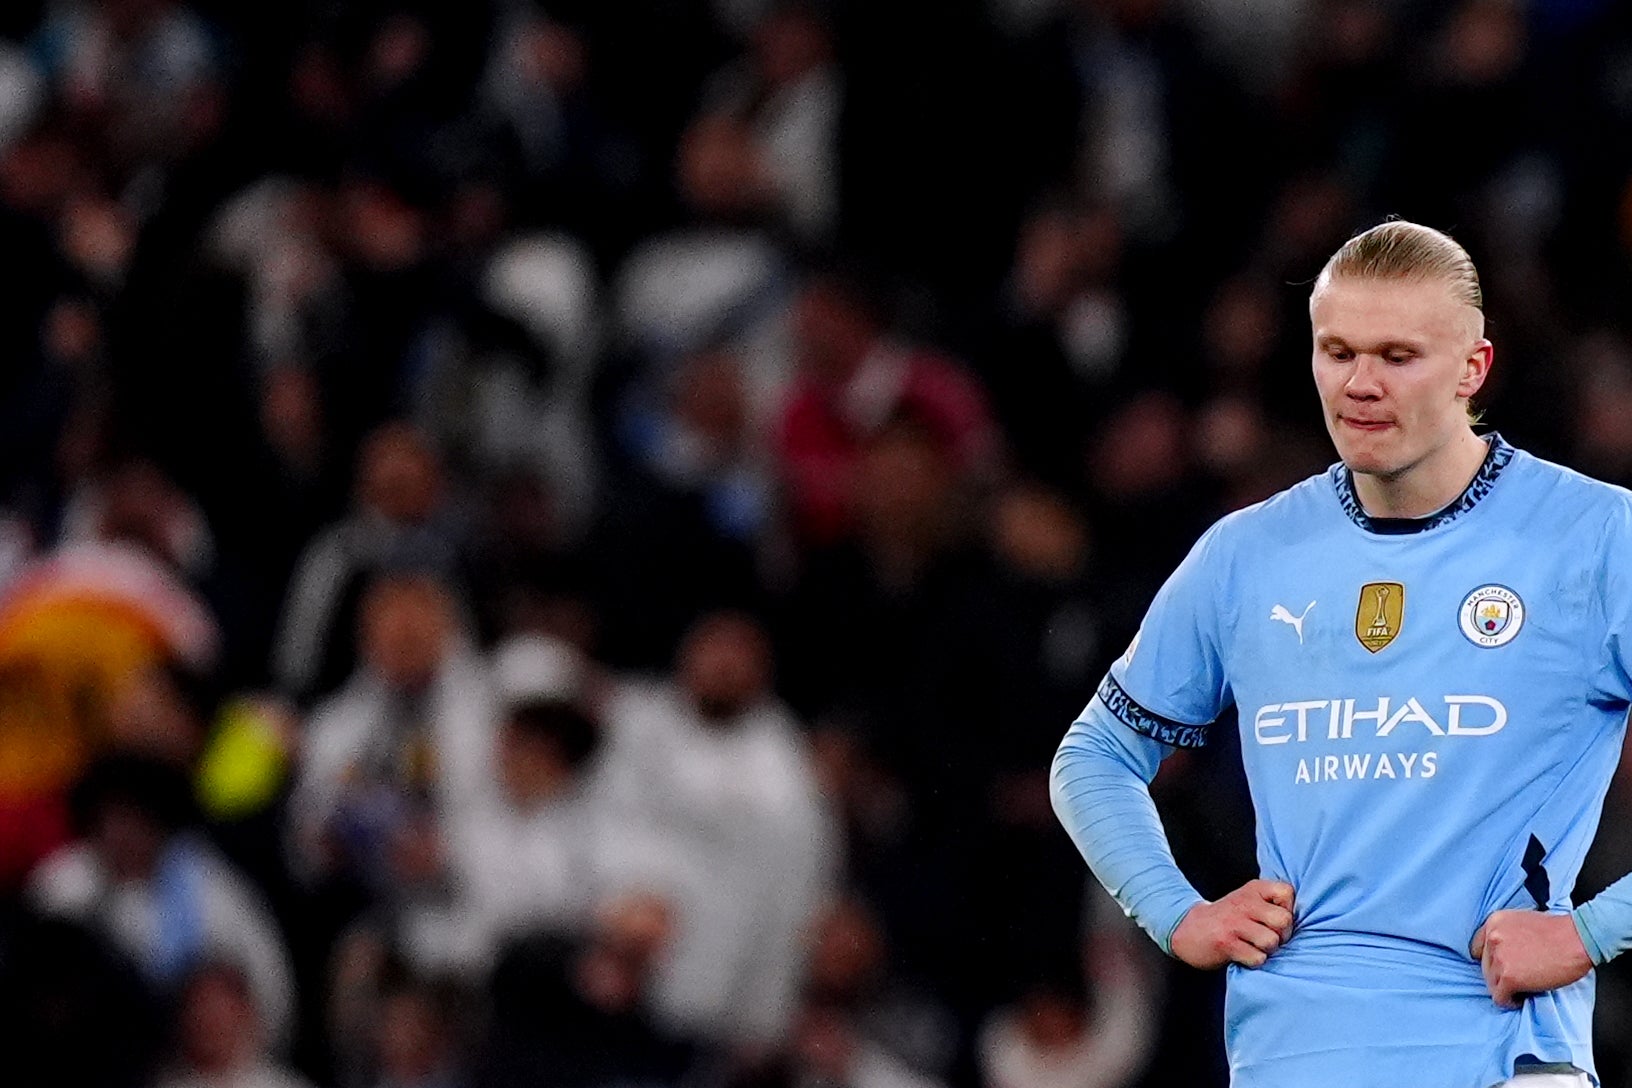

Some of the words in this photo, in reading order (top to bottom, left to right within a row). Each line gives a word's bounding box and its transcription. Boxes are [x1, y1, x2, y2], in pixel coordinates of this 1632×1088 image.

[1467, 588, 1520, 609] MANCHESTER
[1367, 627, 1389, 636] FIFA
[1254, 695, 1508, 745] ETIHAD
[1294, 751, 1438, 784] AIRWAYS
